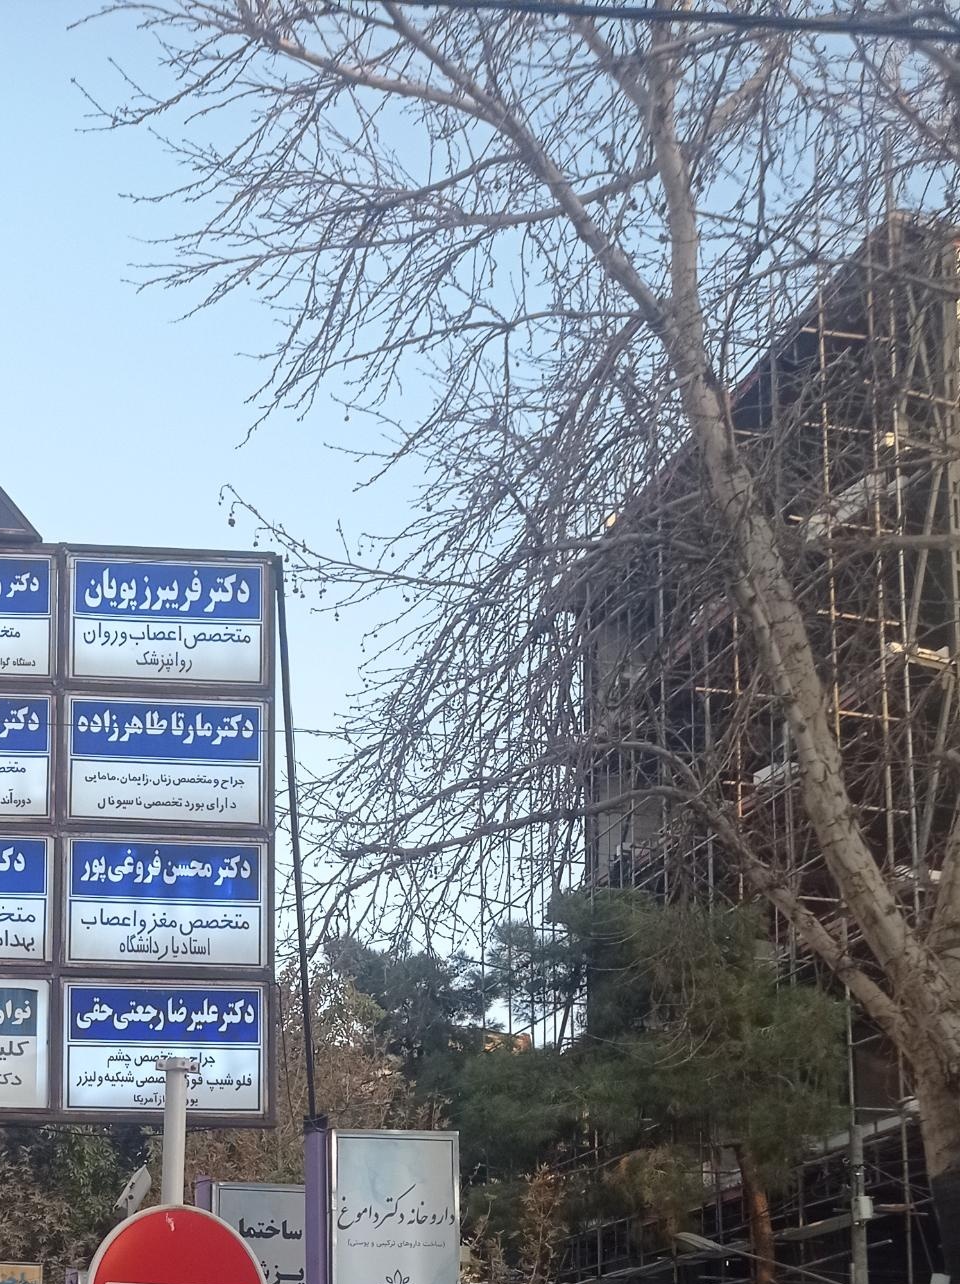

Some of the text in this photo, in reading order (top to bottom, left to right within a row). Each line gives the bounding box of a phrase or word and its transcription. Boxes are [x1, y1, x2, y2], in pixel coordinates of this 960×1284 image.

[13, 658, 36, 666] دستگاه
[136, 651, 192, 673] روانپزشک
[0, 705, 40, 738] دکتر
[98, 796, 236, 813] دارای بورد تخصصی ناسیونال
[120, 934, 210, 960] استادیار دانشگاه
[76, 997, 113, 1029] حقی
[167, 997, 218, 1032] علیرضا
[218, 998, 255, 1032] دکتر
[337, 1184, 456, 1230] داروخانه دکتر داموغ
[239, 1218, 303, 1241] ساختما
